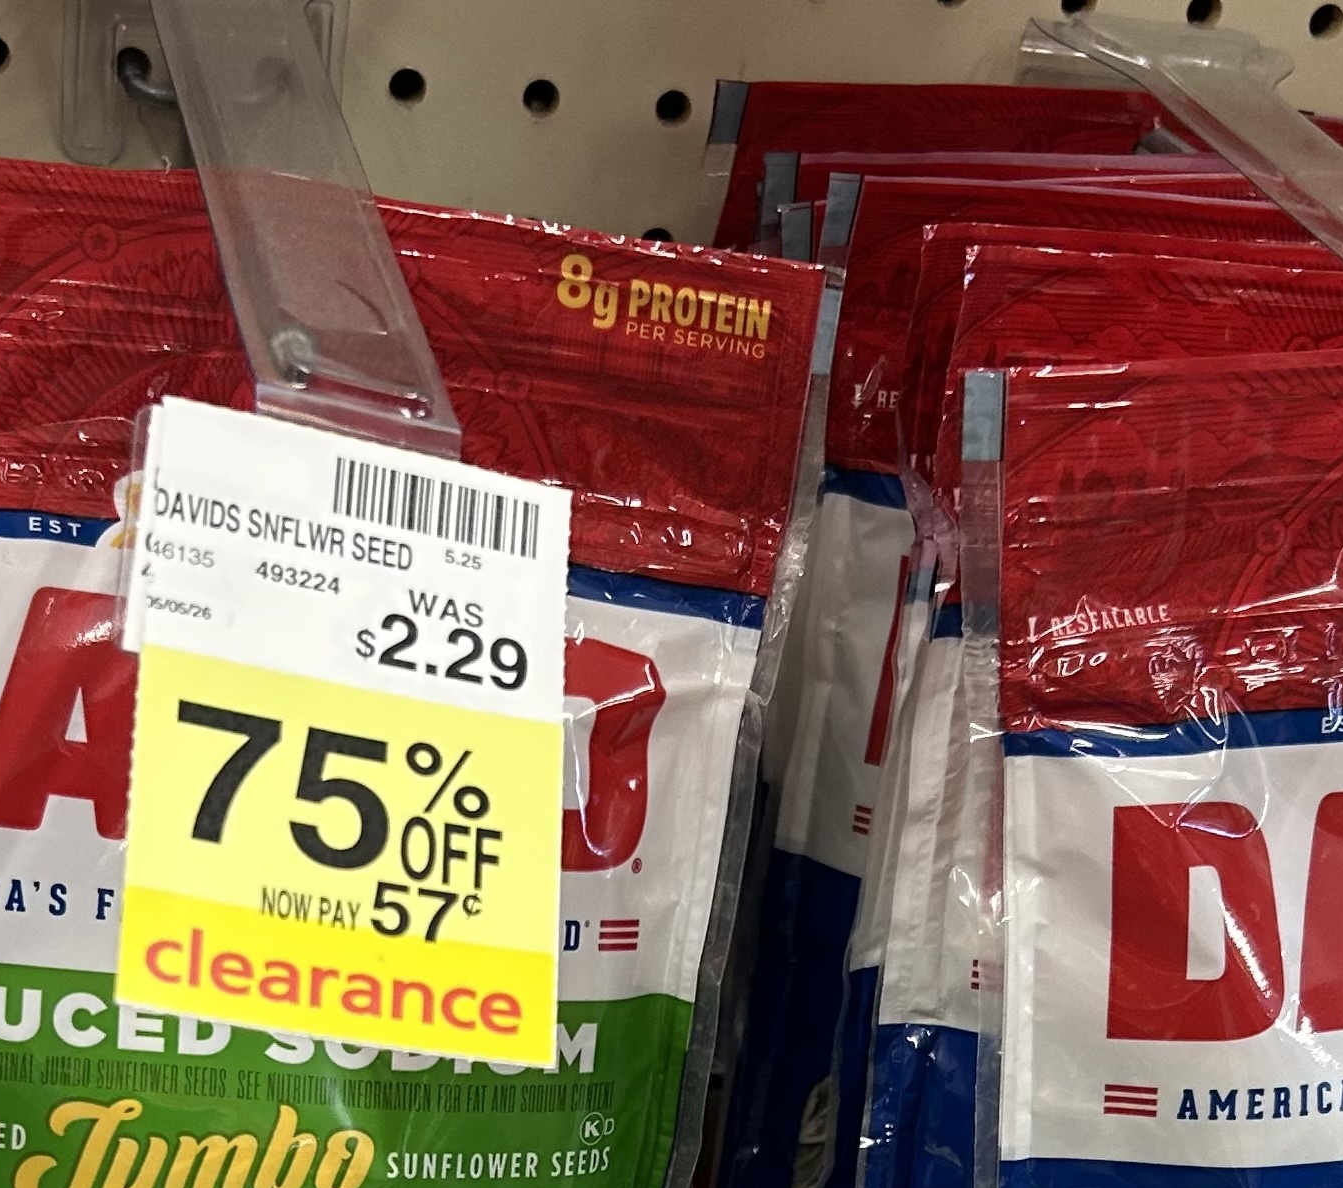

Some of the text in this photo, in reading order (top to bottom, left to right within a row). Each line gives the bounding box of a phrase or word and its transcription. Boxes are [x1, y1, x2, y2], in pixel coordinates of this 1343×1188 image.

[557, 254, 773, 341] 8g PROTEIN
[625, 321, 766, 360] PER SERVING
[28, 515, 82, 538] EST
[155, 487, 482, 572] DAVIDS SNFLWR SEED 5.25
[254, 560, 484, 628] 493224 WAS
[355, 613, 528, 692] $2.29
[400, 816, 503, 892] OFF
[260, 881, 484, 944] NOW PAY 57¢
[144, 927, 523, 1036] clearance
[96, 1058, 431, 1113] SUNFLOWER NUTRITION INFORMATION
[386, 1152, 539, 1181] SUNFLOWER
[550, 1146, 611, 1177] SEEDS
